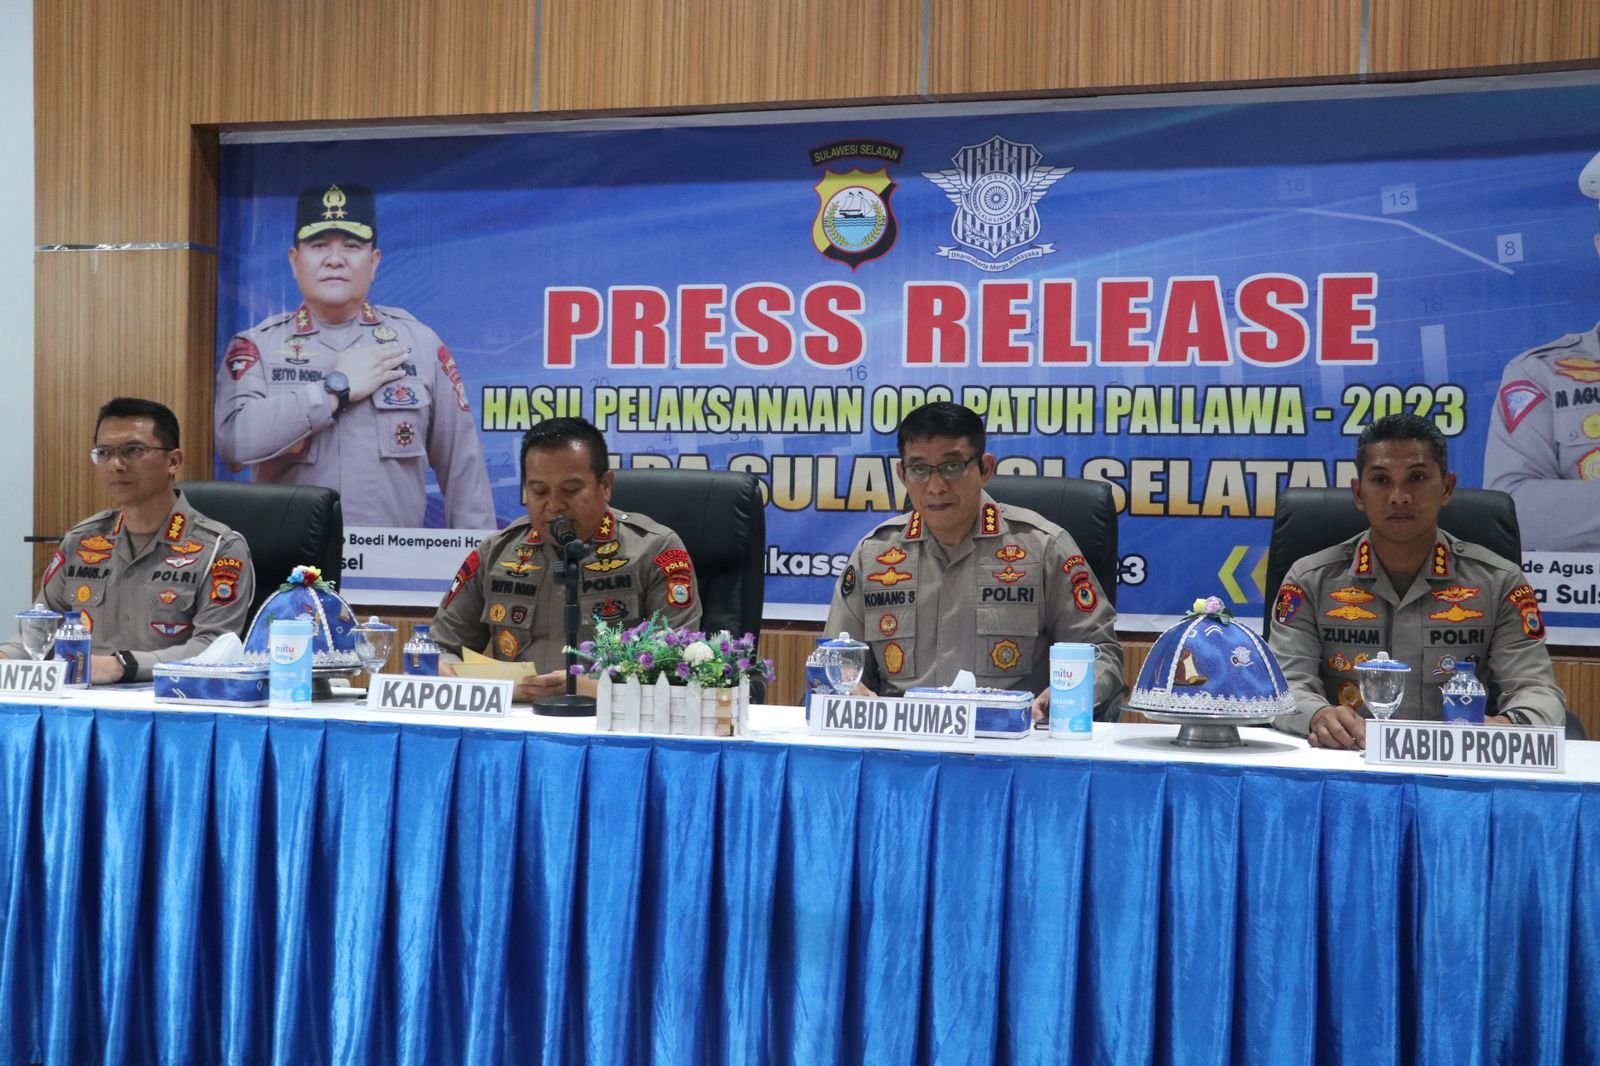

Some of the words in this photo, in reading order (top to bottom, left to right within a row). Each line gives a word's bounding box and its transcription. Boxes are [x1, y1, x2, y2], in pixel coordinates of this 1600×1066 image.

[814, 145, 858, 162] SULAWESI
[860, 145, 899, 160] SELATAN
[1389, 190, 1410, 206] 15
[1504, 240, 1516, 256] 8
[545, 281, 867, 369] PRESS
[904, 274, 1378, 367] RELEASE
[846, 364, 868, 381] 16
[1555, 390, 1568, 408] M
[593, 385, 864, 434] PELAKSANAAN
[961, 384, 1096, 434] PATUH
[1104, 384, 1307, 435] PALLAWA
[1341, 383, 1467, 436] 2023
[349, 534, 385, 546] Boedi
[388, 534, 462, 549] Moempoeni
[211, 559, 241, 570] POLDA
[664, 561, 689, 573] POLDA
[1522, 560, 1544, 574] de
[1549, 560, 1594, 578] Agus
[152, 570, 197, 584] POLRI
[582, 574, 631, 594] POLRI
[863, 592, 906, 609] KOMANG
[982, 587, 1034, 603] POLRI
[1556, 584, 1600, 605] Sul
[1323, 628, 1380, 645] ZULHAM
[1430, 629, 1485, 645] POLRI
[275, 643, 295, 654] mitu
[0, 663, 57, 692] NTAS
[1053, 667, 1073, 678] mitu
[381, 680, 503, 713] KAPOLDA
[825, 699, 888, 731] KABID
[894, 702, 967, 736] HUMAS
[1385, 727, 1454, 761] KABID
[1462, 730, 1555, 767] PROPAM
